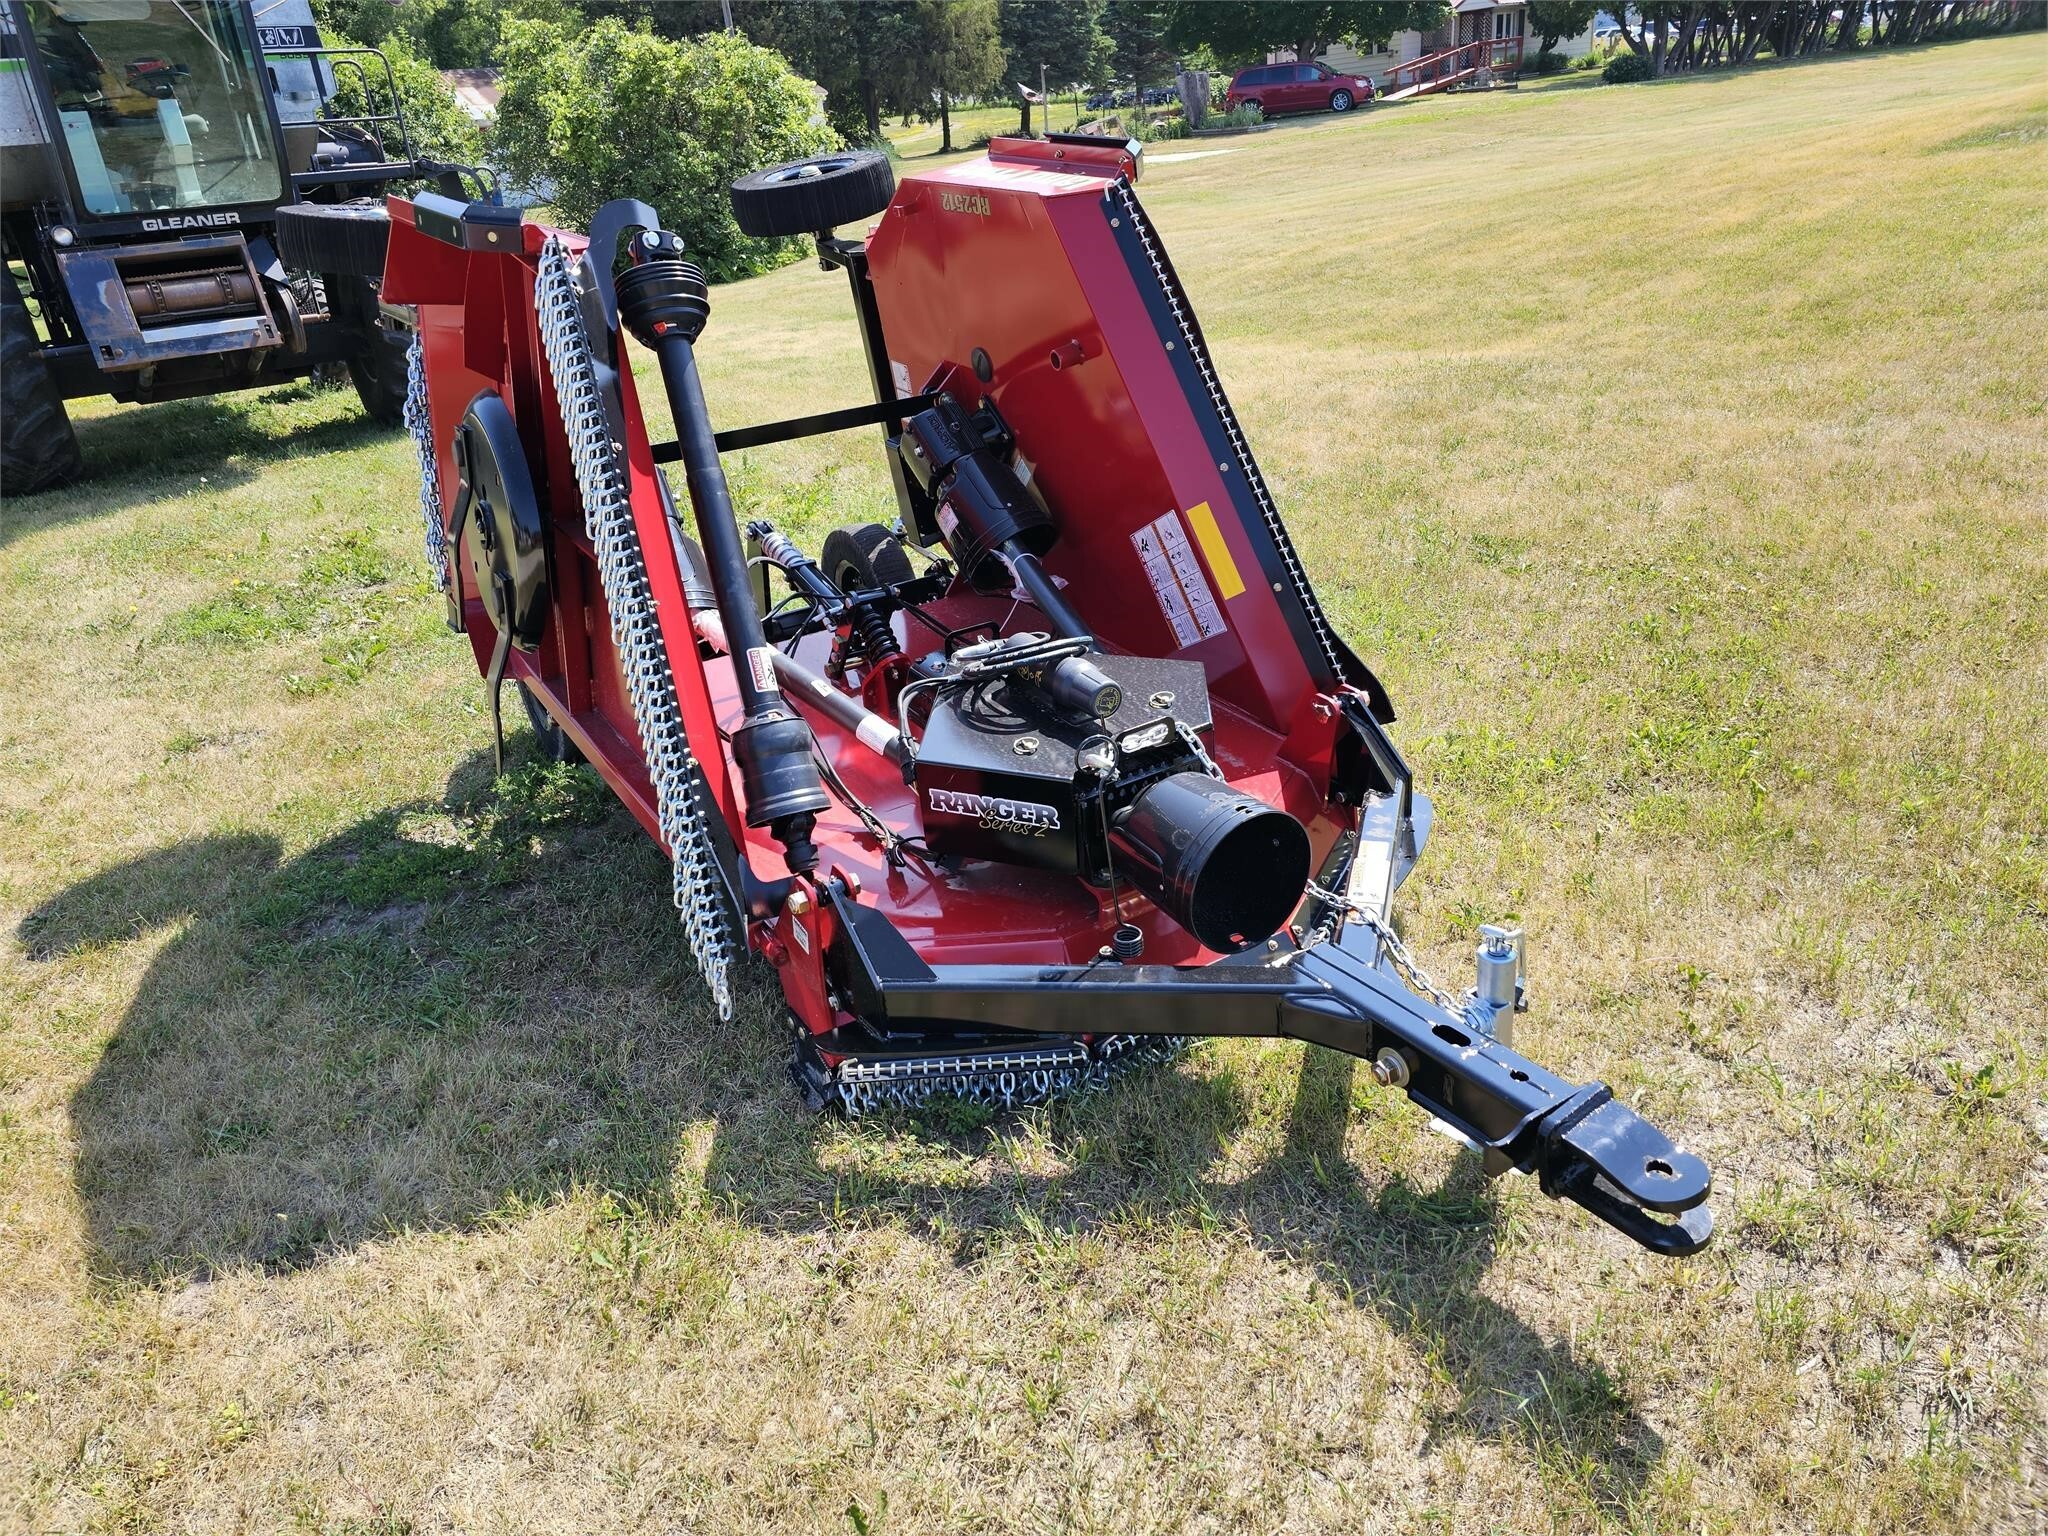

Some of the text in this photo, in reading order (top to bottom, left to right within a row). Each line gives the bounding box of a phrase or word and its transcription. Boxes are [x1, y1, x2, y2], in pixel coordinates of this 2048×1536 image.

[941, 192, 991, 216] RC2512
[142, 212, 240, 231] GLEANER
[751, 650, 765, 680] DANGER
[929, 788, 1061, 829] RANGER
[979, 808, 1050, 837] Series 2
